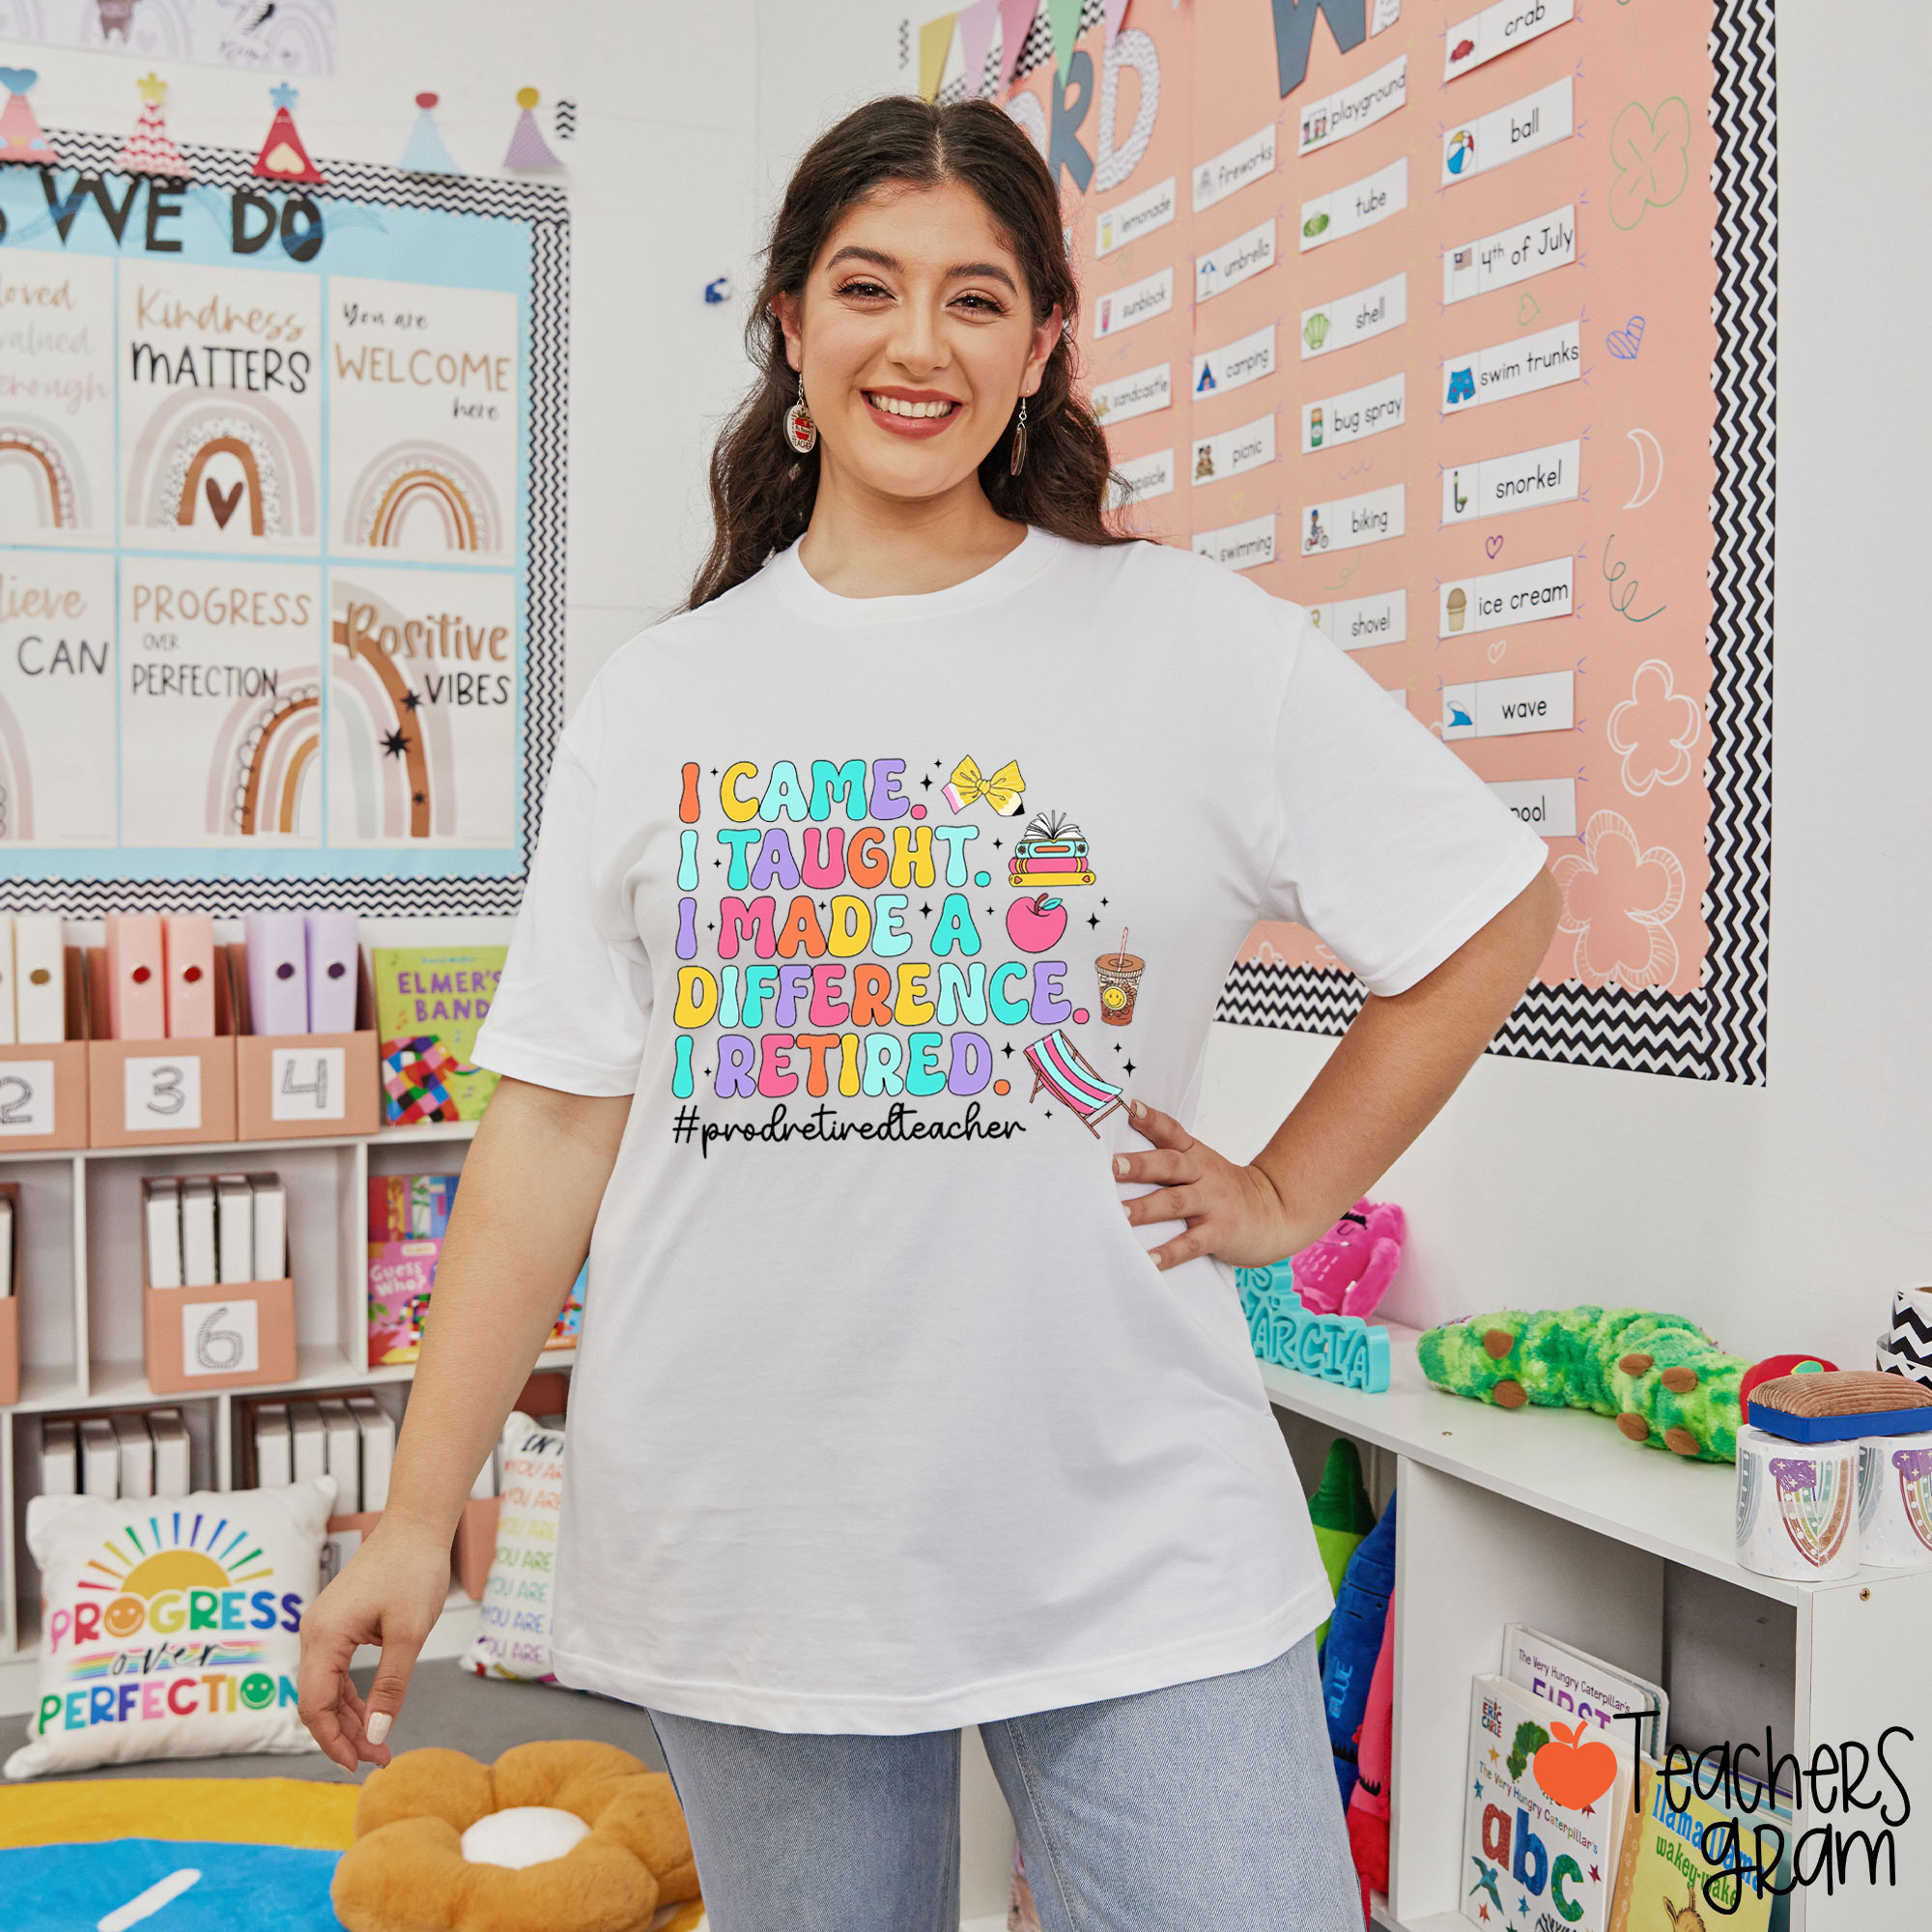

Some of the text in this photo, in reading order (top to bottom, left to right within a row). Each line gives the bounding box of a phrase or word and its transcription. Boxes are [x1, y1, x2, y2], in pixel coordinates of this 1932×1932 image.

[1504, 0, 1546, 37] crab
[1330, 63, 1406, 128] playground
[1510, 106, 1540, 144] ball
[1218, 142, 1273, 188] fireworks
[40, 168, 324, 263] WE DO
[1355, 190, 1387, 217] tube
[1224, 238, 1270, 278] umbrella
[1481, 223, 1574, 274] 4th of July
[135, 284, 306, 342] Kindness
[343, 301, 429, 329] You are
[1355, 296, 1386, 330] shell
[334, 341, 511, 392] WELCOME
[1225, 346, 1269, 380] camping
[1480, 340, 1579, 387] swim trunks
[452, 396, 498, 420] here
[1333, 396, 1404, 433] bug spray
[1232, 438, 1264, 465] picnic
[1495, 459, 1563, 499] snorkel
[1351, 507, 1389, 534] biking
[1219, 533, 1273, 563] swimming
[131, 583, 312, 627] PROGRESS
[1478, 582, 1570, 617] ice cream
[345, 601, 509, 662] Positive
[1350, 606, 1391, 637] shovel
[16, 635, 109, 676] CAN
[142, 632, 180, 652] OVER
[131, 663, 278, 698] PERFECTION
[424, 671, 512, 707] VIBES
[1501, 698, 1548, 721] wave
[678, 758, 927, 824] I CAME.
[676, 824, 991, 892] I TAUGHT.
[674, 893, 982, 960] I MADE A
[415, 1000, 490, 1021] BAND
[672, 960, 1091, 1029] DIFFERENCE.
[281, 1057, 329, 1109] 4
[671, 1031, 1011, 1098] I RETIRED.
[0, 1075, 34, 1124] 2
[147, 1065, 186, 1115] 3
[671, 1101, 1027, 1158] #prodretiredteacher
[369, 1262, 423, 1282] Guess
[373, 1273, 427, 1296] Who?
[196, 1306, 244, 1370] 6
[1241, 1293, 1370, 1387] ARCIA
[522, 1549, 554, 1573] ARE
[515, 1579, 550, 1604] ARE
[512, 1609, 546, 1634] ARE
[111, 1640, 242, 1675] over
[510, 1638, 544, 1664] ARE
[1326, 1658, 1353, 1719] BLUE
[1518, 1648, 1632, 1714] The Very Hungry Caterpillar's
[1481, 1715, 1502, 1739] CARLE
[1482, 1701, 1503, 1725] ERIC
[1479, 1760, 1599, 1855] The Very Hungry Caterpillar's
[1482, 1803, 1585, 1922] abc
